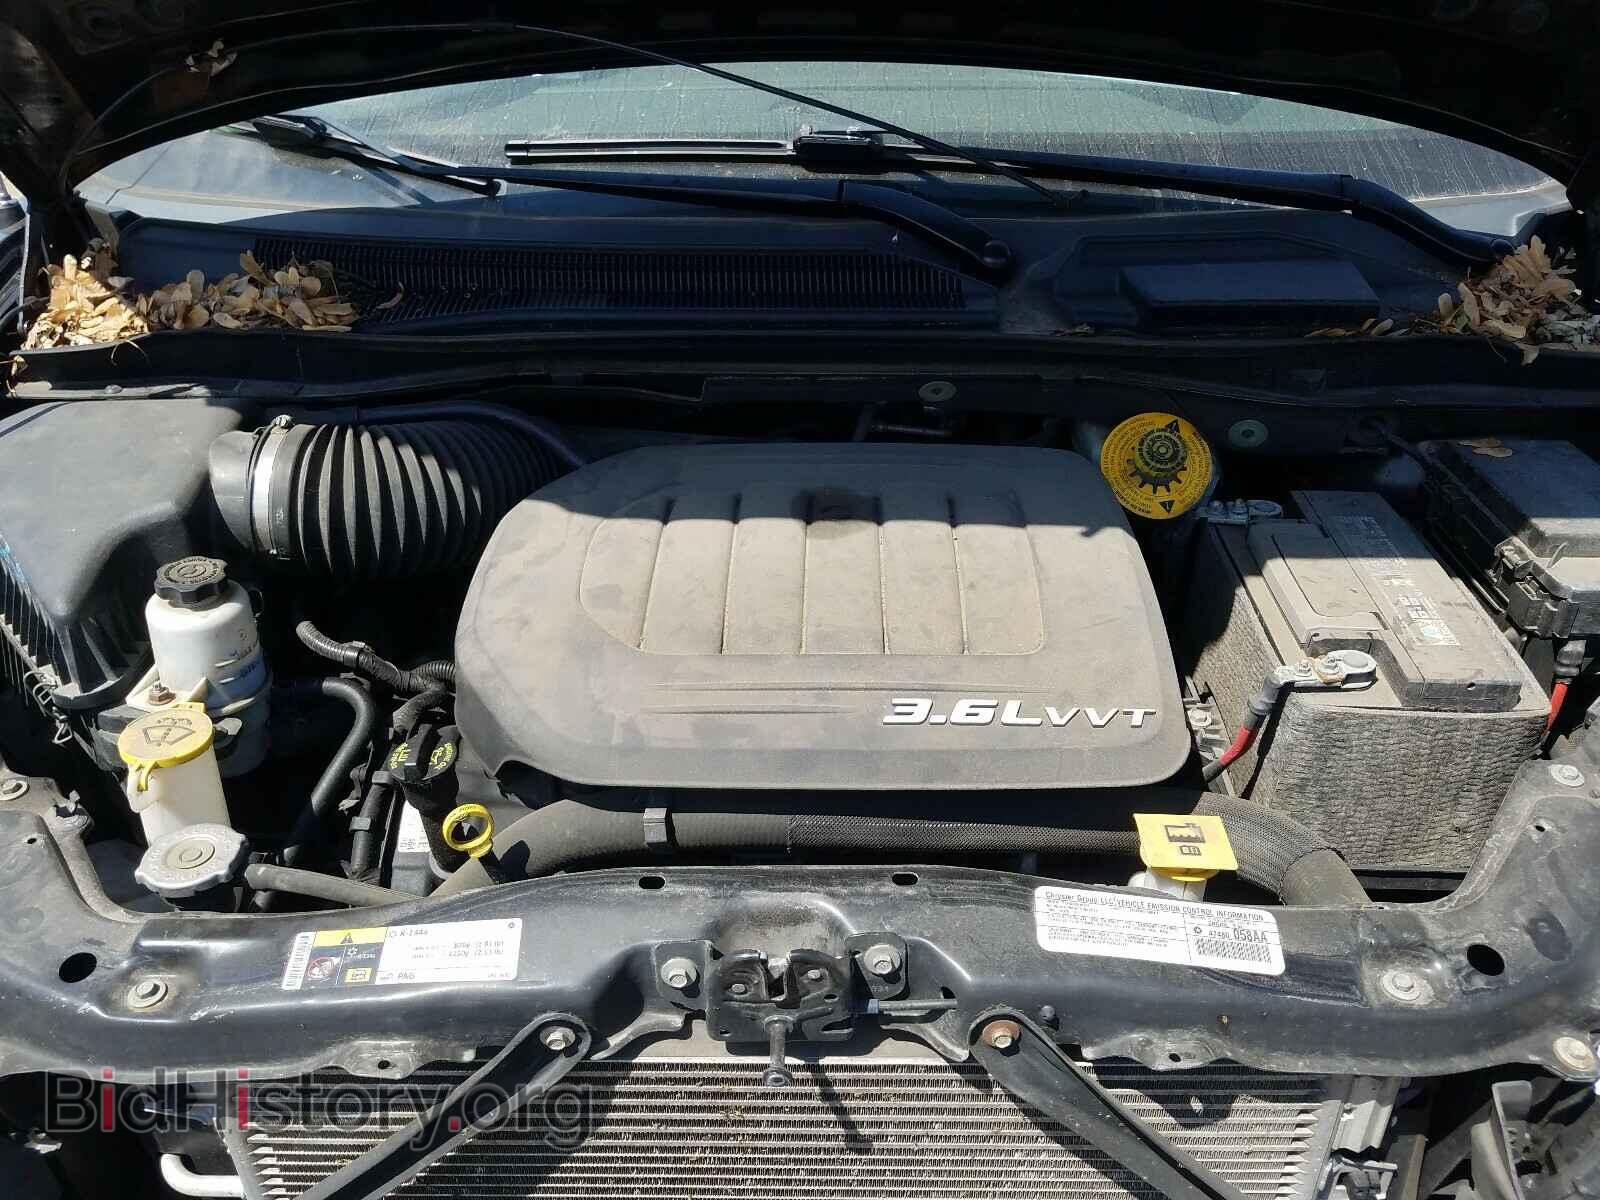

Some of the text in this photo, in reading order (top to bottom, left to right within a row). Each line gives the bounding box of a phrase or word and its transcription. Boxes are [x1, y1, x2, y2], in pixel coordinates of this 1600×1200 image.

[882, 697, 1158, 729] 3.6L VVT
[1045, 890, 1074, 903] Chrysler
[1077, 894, 1098, 906] Group
[1118, 899, 1145, 910] VEHICLE
[1147, 902, 1180, 913] EMISSION
[1182, 905, 1212, 916] CONTROL
[1216, 910, 1264, 921] INFORMATION
[1233, 928, 1268, 943] 058AA
